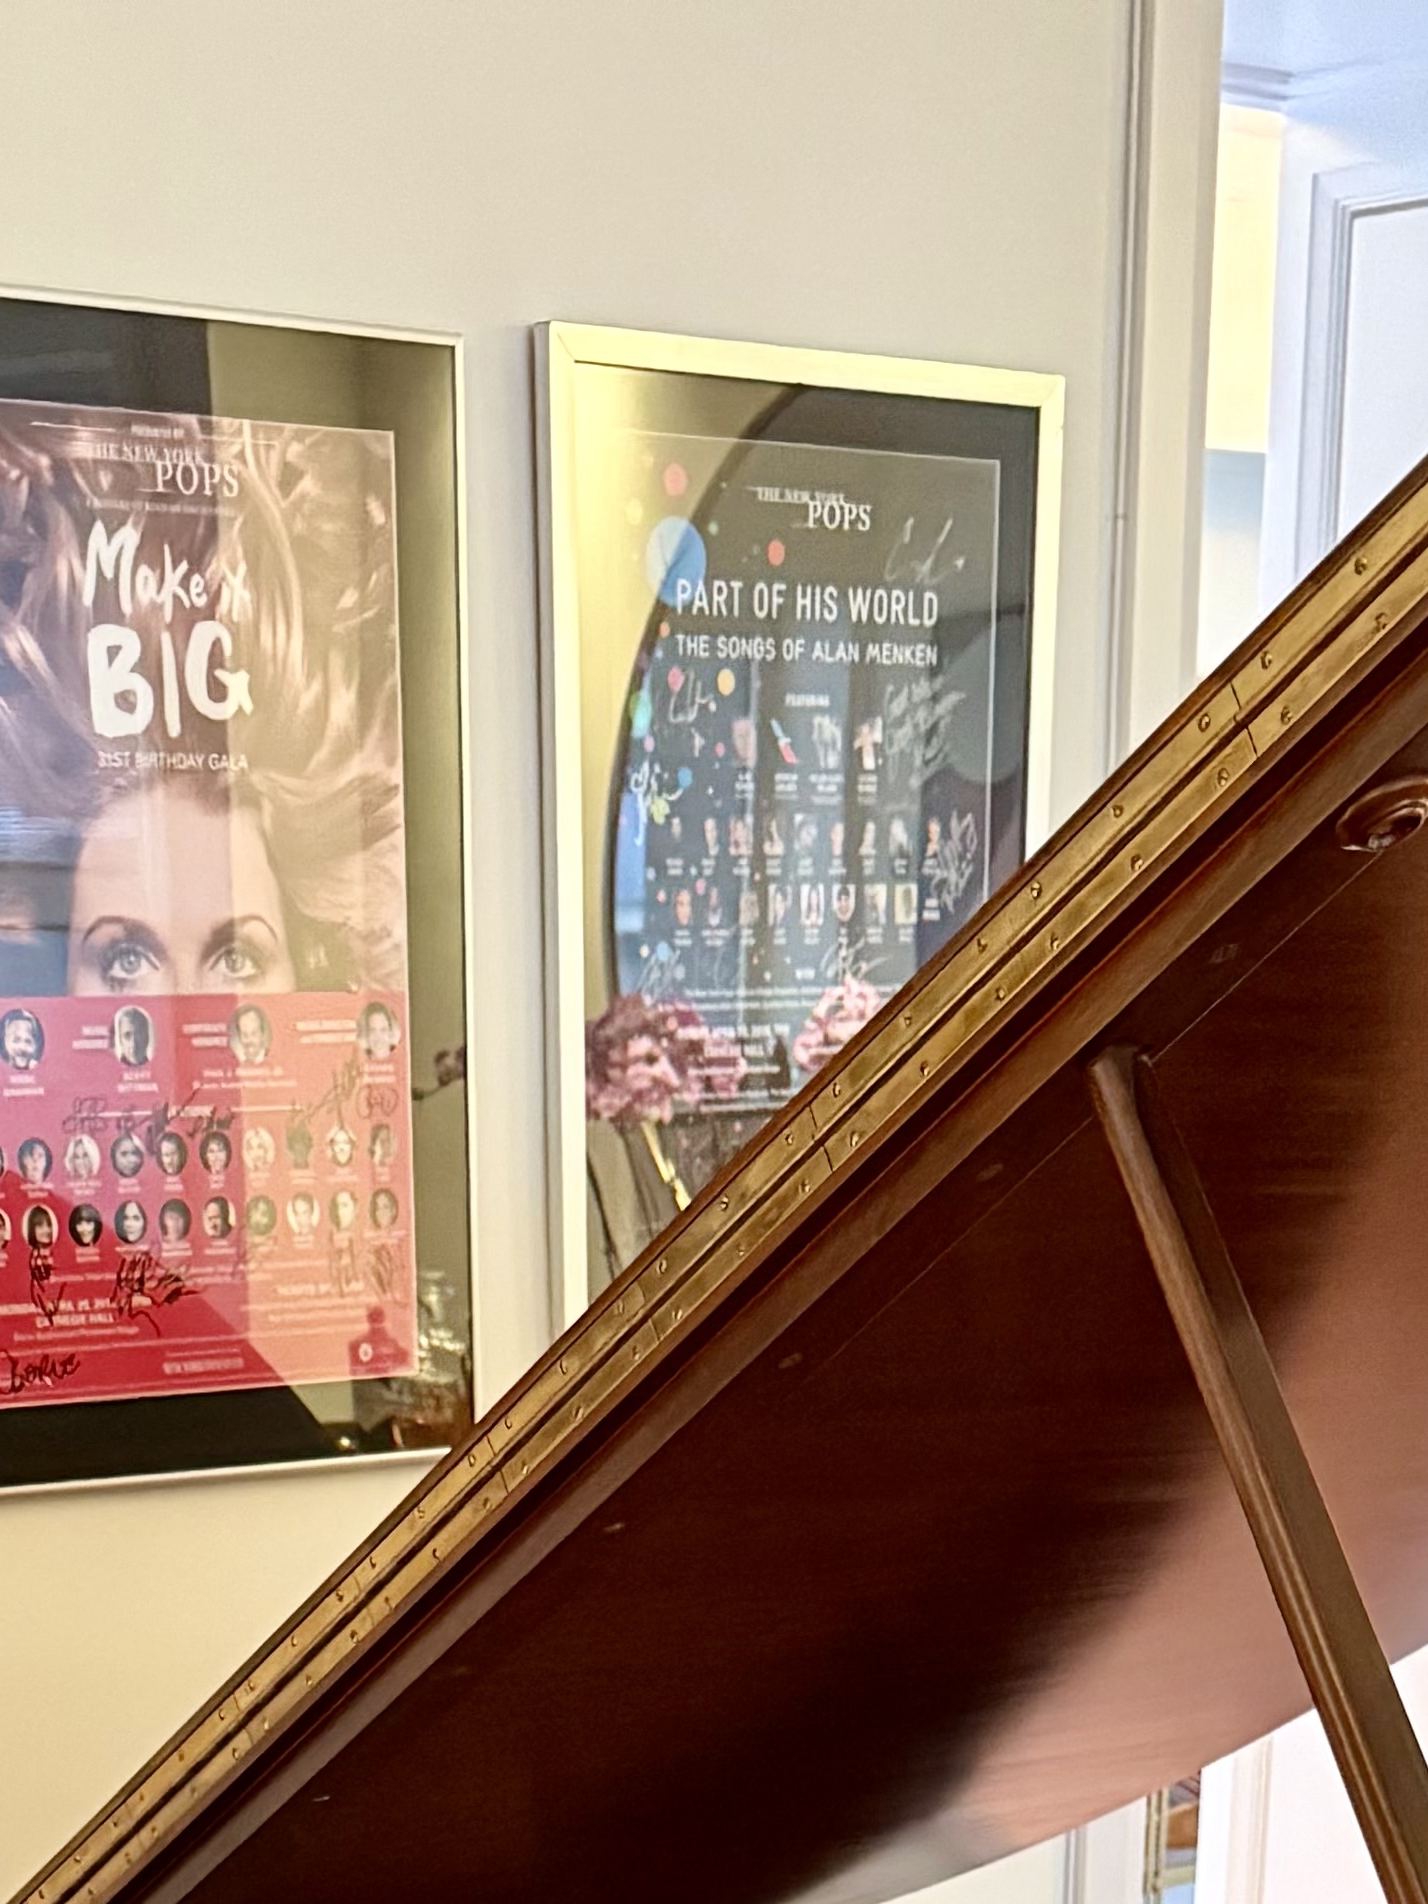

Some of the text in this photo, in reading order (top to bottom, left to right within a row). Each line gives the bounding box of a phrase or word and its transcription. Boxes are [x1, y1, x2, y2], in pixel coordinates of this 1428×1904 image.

[122, 444, 159, 461] NEW
[162, 447, 206, 465] YORK
[155, 460, 239, 497] POPS
[808, 501, 872, 531] POPS
[82, 519, 208, 624] Make
[676, 579, 938, 626] PART OF HIS WORLD
[676, 634, 938, 666] THE SONGS OF ALAN MENKEN
[87, 620, 254, 738] BIG
[135, 751, 204, 769] BIRTHDAY
[209, 752, 249, 771] GALA
